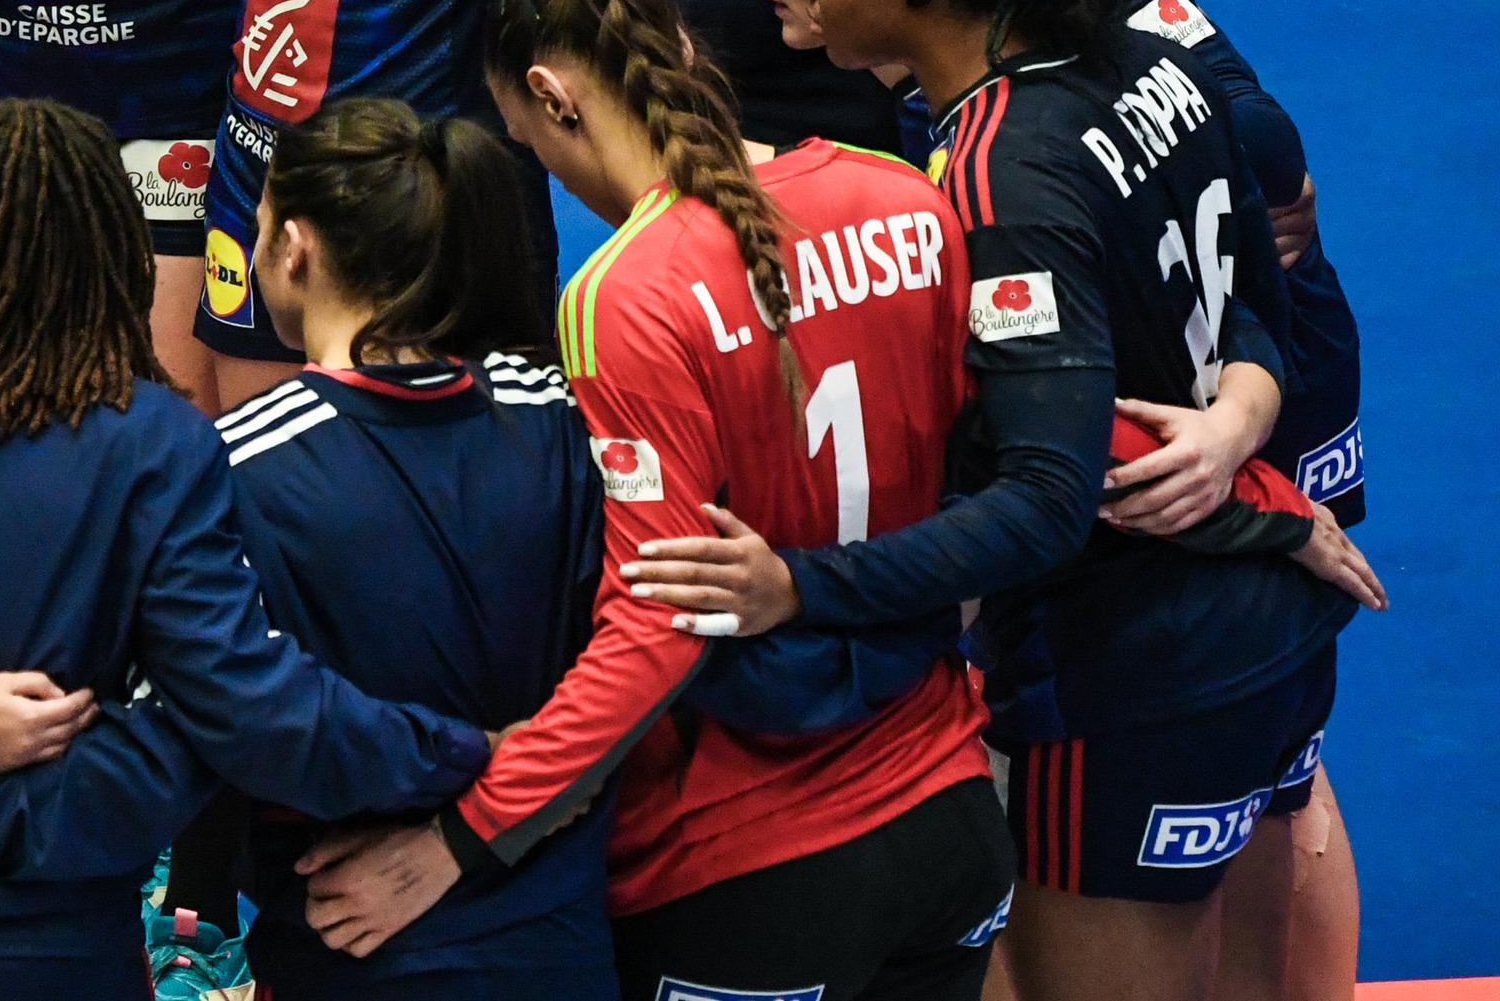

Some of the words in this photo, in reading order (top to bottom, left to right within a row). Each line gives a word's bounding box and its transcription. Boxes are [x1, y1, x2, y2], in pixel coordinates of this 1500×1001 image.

[17, 3, 108, 26] CAISSE
[1080, 127, 1147, 199] P.
[691, 280, 753, 353] L.
[969, 308, 1055, 337] Boulangère
[805, 360, 870, 547] 1
[1302, 435, 1357, 499] FDJ
[1152, 812, 1241, 856] FDJ
